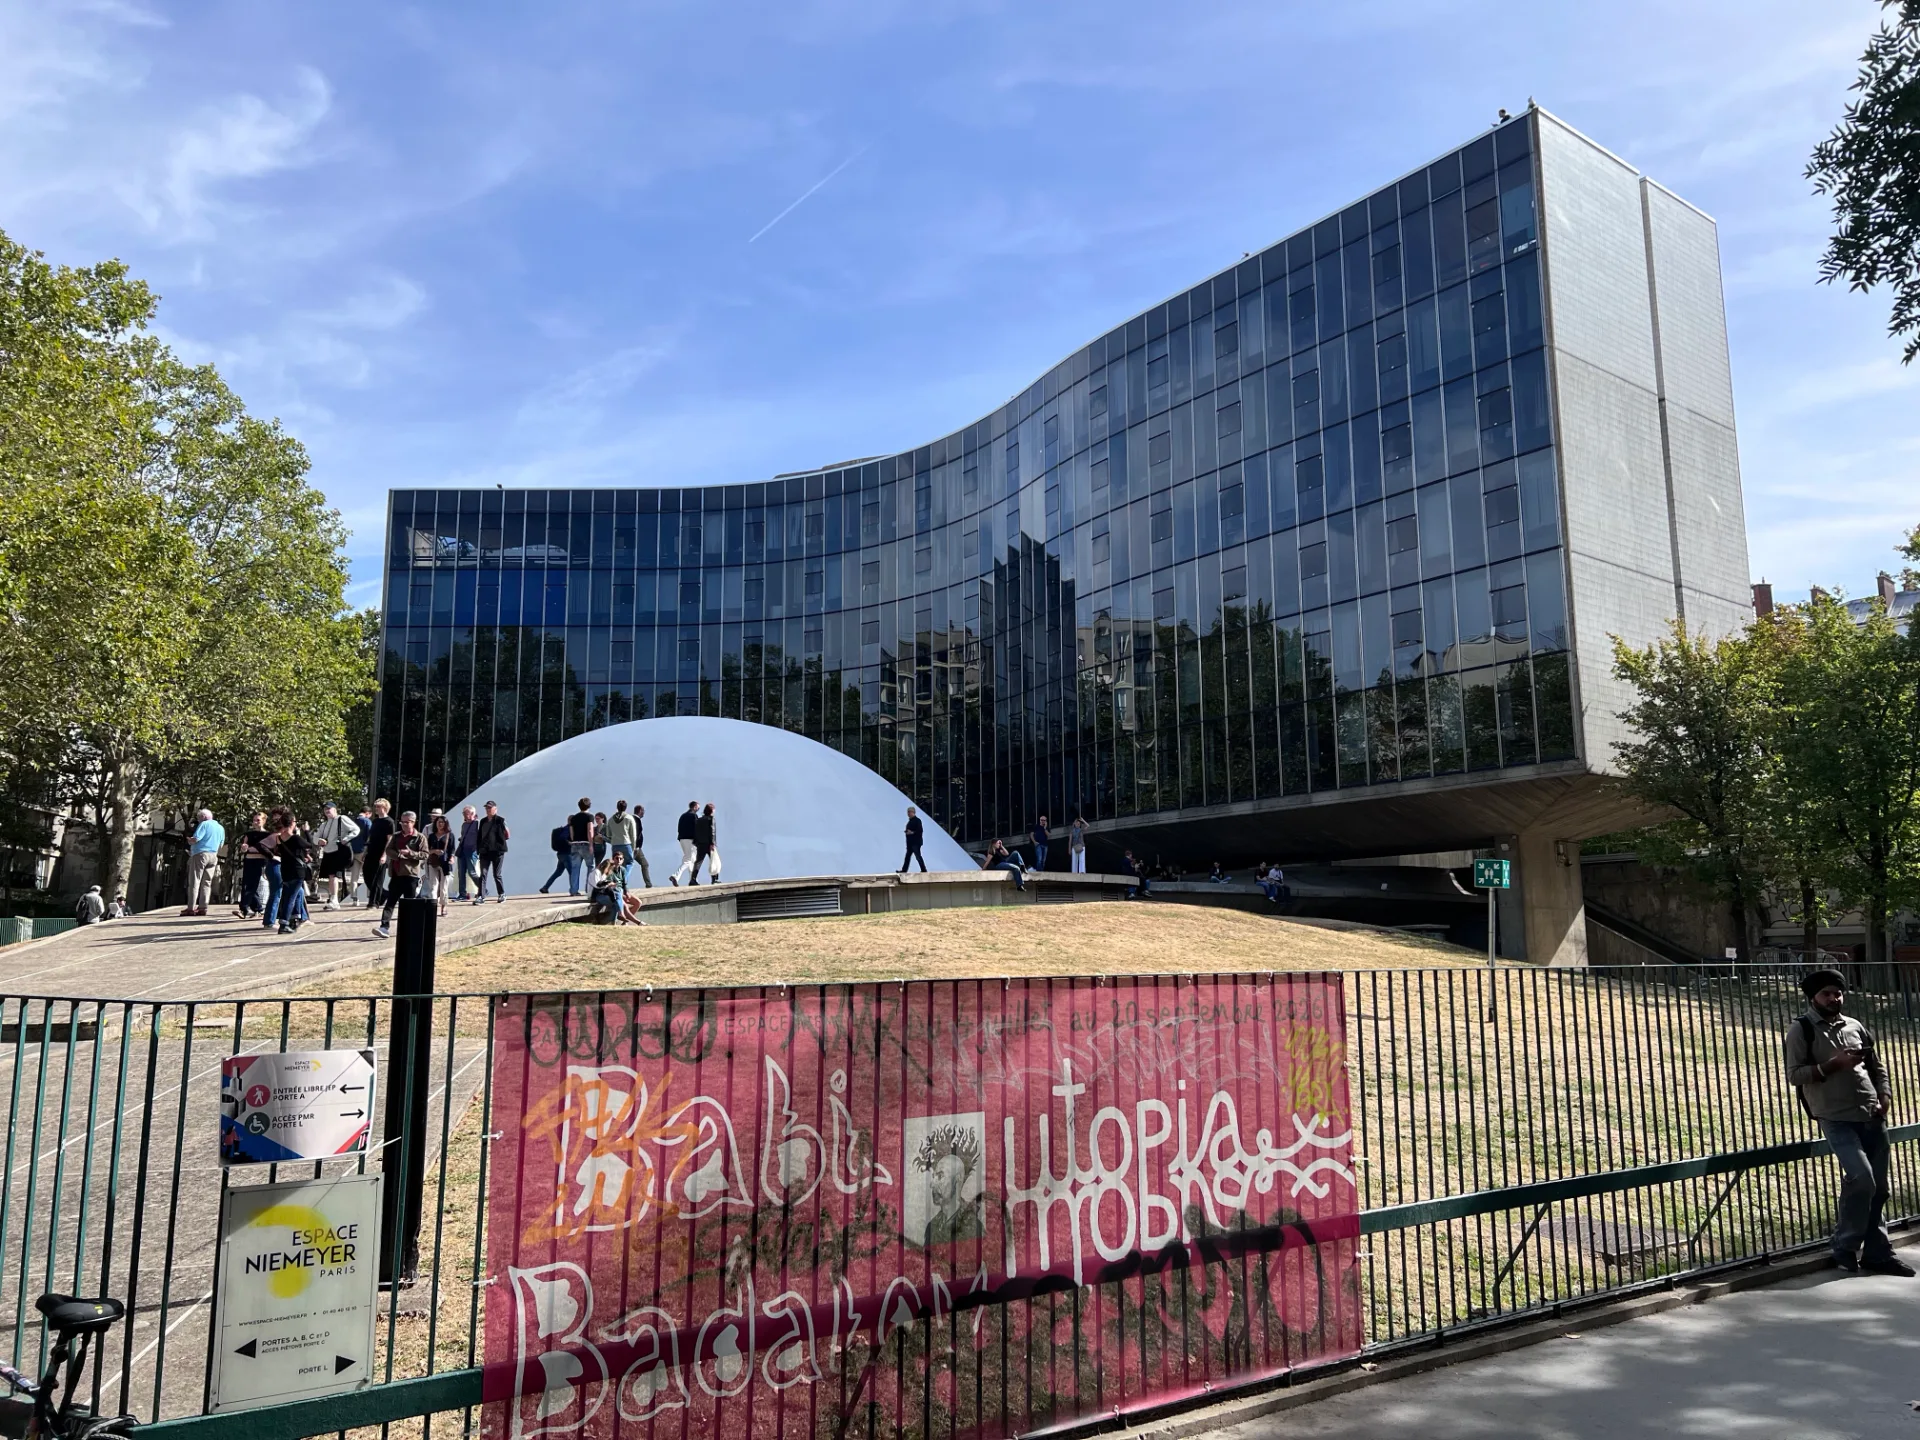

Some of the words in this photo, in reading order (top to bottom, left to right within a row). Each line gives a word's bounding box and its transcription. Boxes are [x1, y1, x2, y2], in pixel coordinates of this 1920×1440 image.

[1071, 1009, 1097, 1032] au
[1110, 999, 1138, 1027] 20
[1275, 994, 1323, 1022] 2026
[724, 1014, 788, 1036] ESPACE
[273, 1085, 302, 1095] ENTRÉE
[303, 1085, 323, 1093] LIBRE
[272, 1093, 298, 1101] PORTE
[271, 1114, 296, 1123] ACCÈS
[297, 1113, 315, 1121] PMR
[271, 1121, 297, 1130] PORTE
[292, 1223, 358, 1247] ESPACE
[245, 1243, 356, 1275] NIEMEYER
[320, 1265, 356, 1278] PARIS
[261, 1336, 291, 1347] PORTES
[298, 1365, 322, 1375] PORTE
